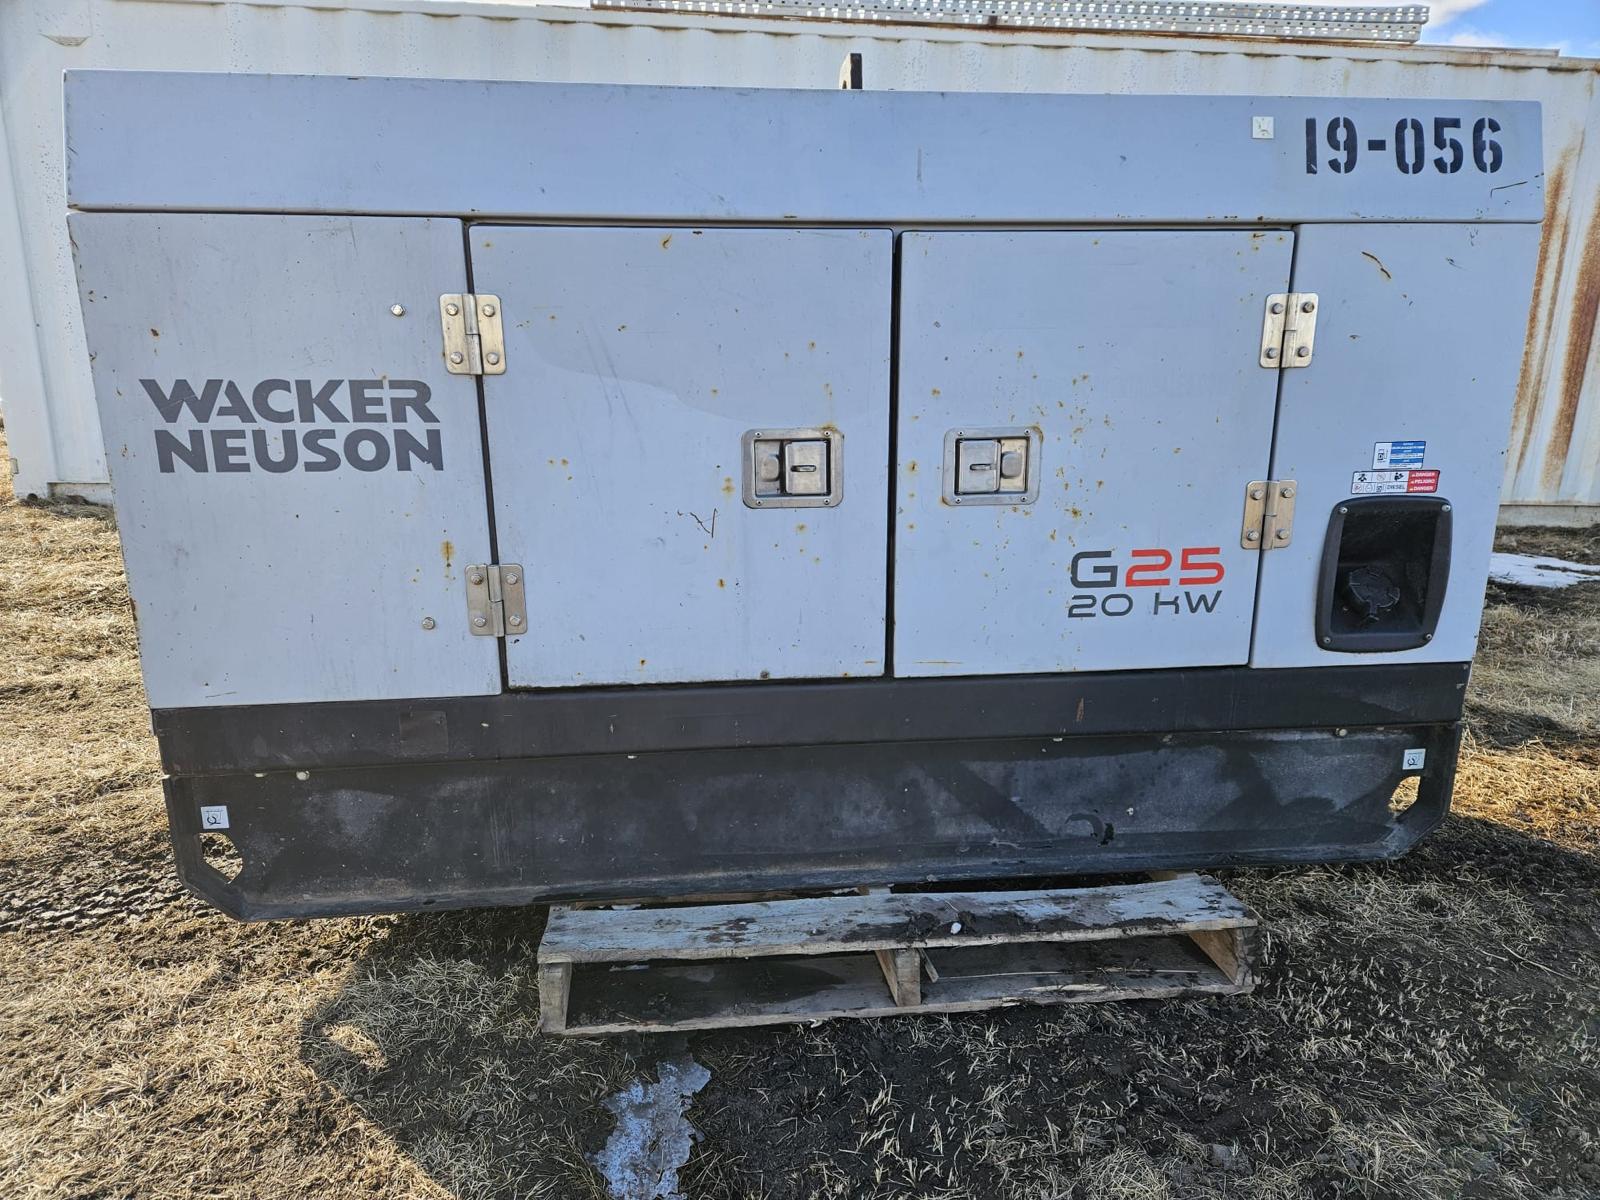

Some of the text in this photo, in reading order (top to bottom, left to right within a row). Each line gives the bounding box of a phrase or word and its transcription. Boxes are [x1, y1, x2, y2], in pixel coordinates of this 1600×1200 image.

[1305, 116, 1504, 175] 19-056
[138, 378, 441, 424] WACKER
[153, 428, 444, 473] NEUSON
[1070, 547, 1225, 589] G25
[1067, 593, 1134, 618] 20
